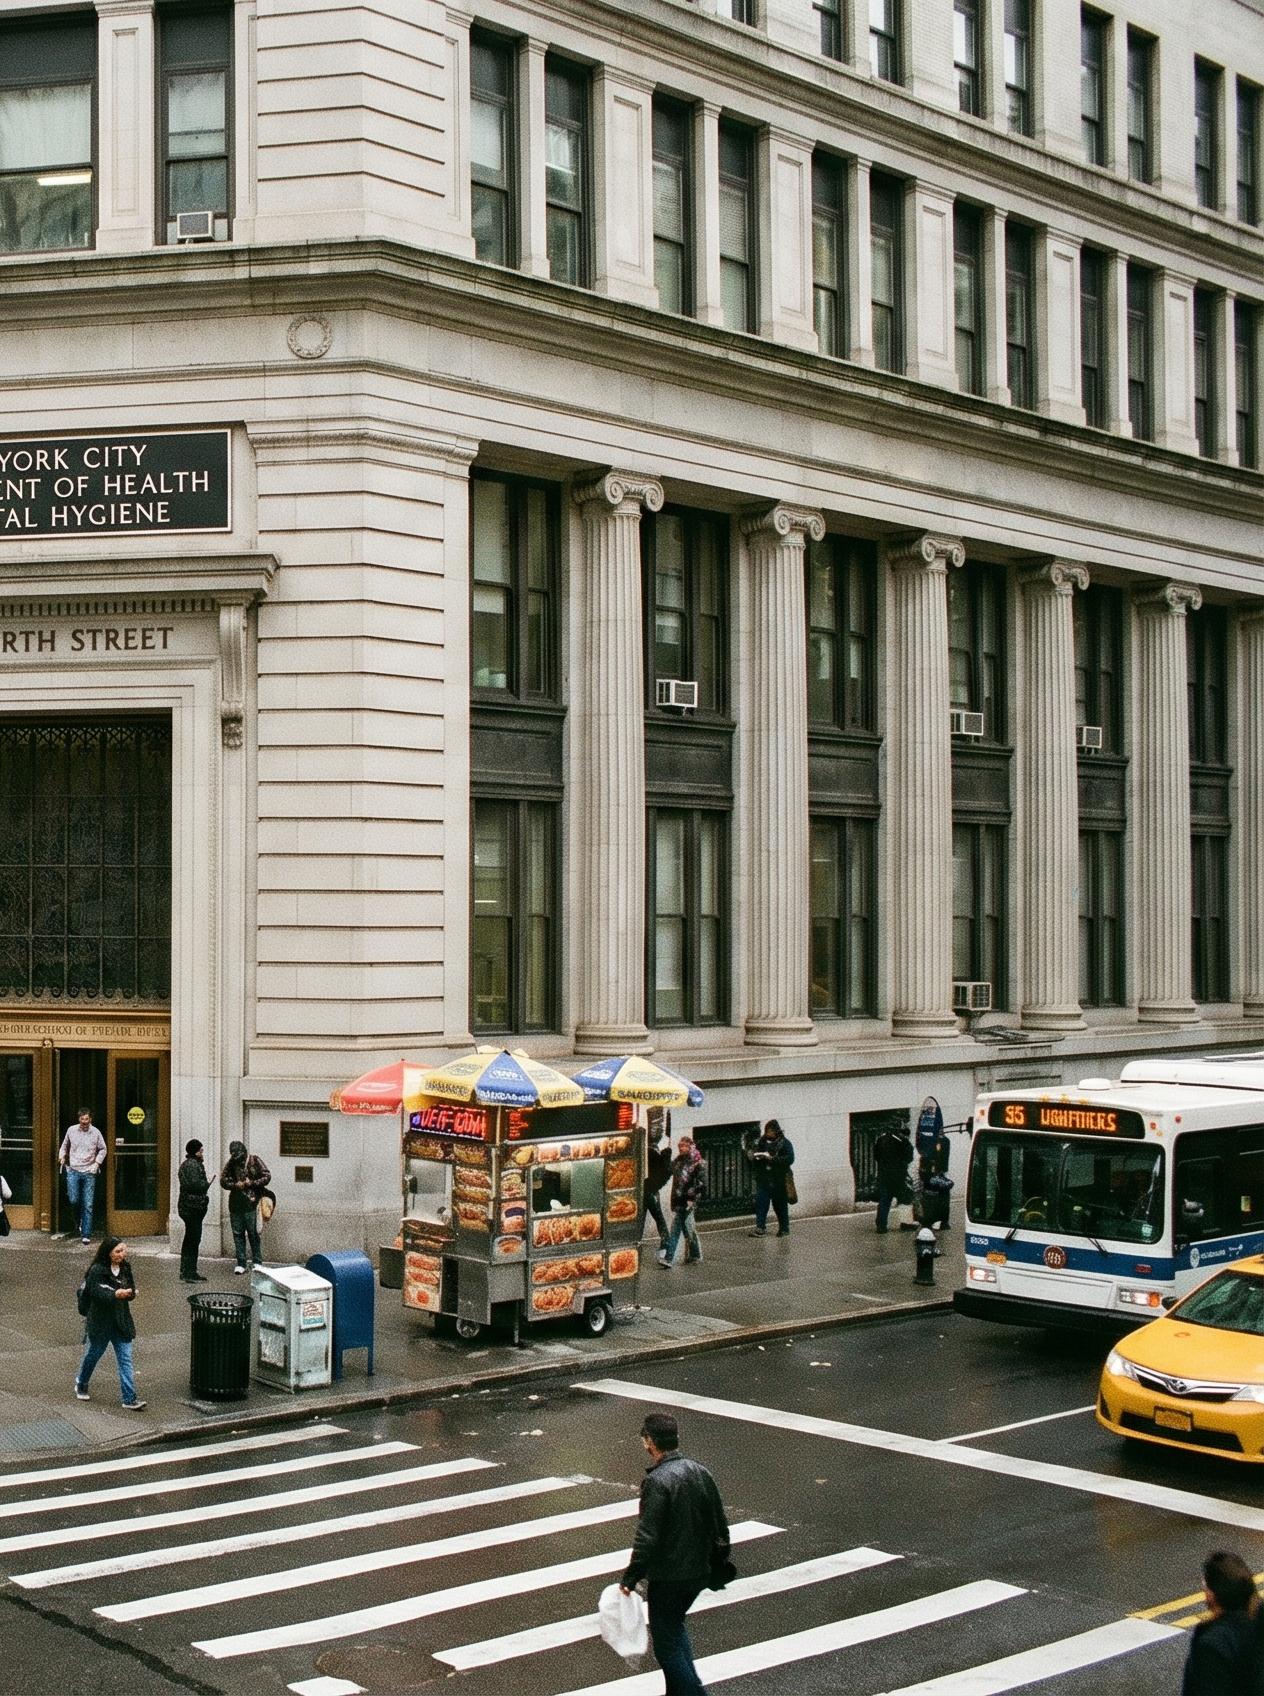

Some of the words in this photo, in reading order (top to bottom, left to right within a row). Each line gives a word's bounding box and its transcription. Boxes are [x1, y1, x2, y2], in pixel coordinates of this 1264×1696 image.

[83, 444, 147, 469] CITY
[53, 476, 89, 498] OF
[104, 470, 209, 496] HEALTH
[51, 501, 171, 527] HYGIENE
[70, 626, 175, 652] STREET
